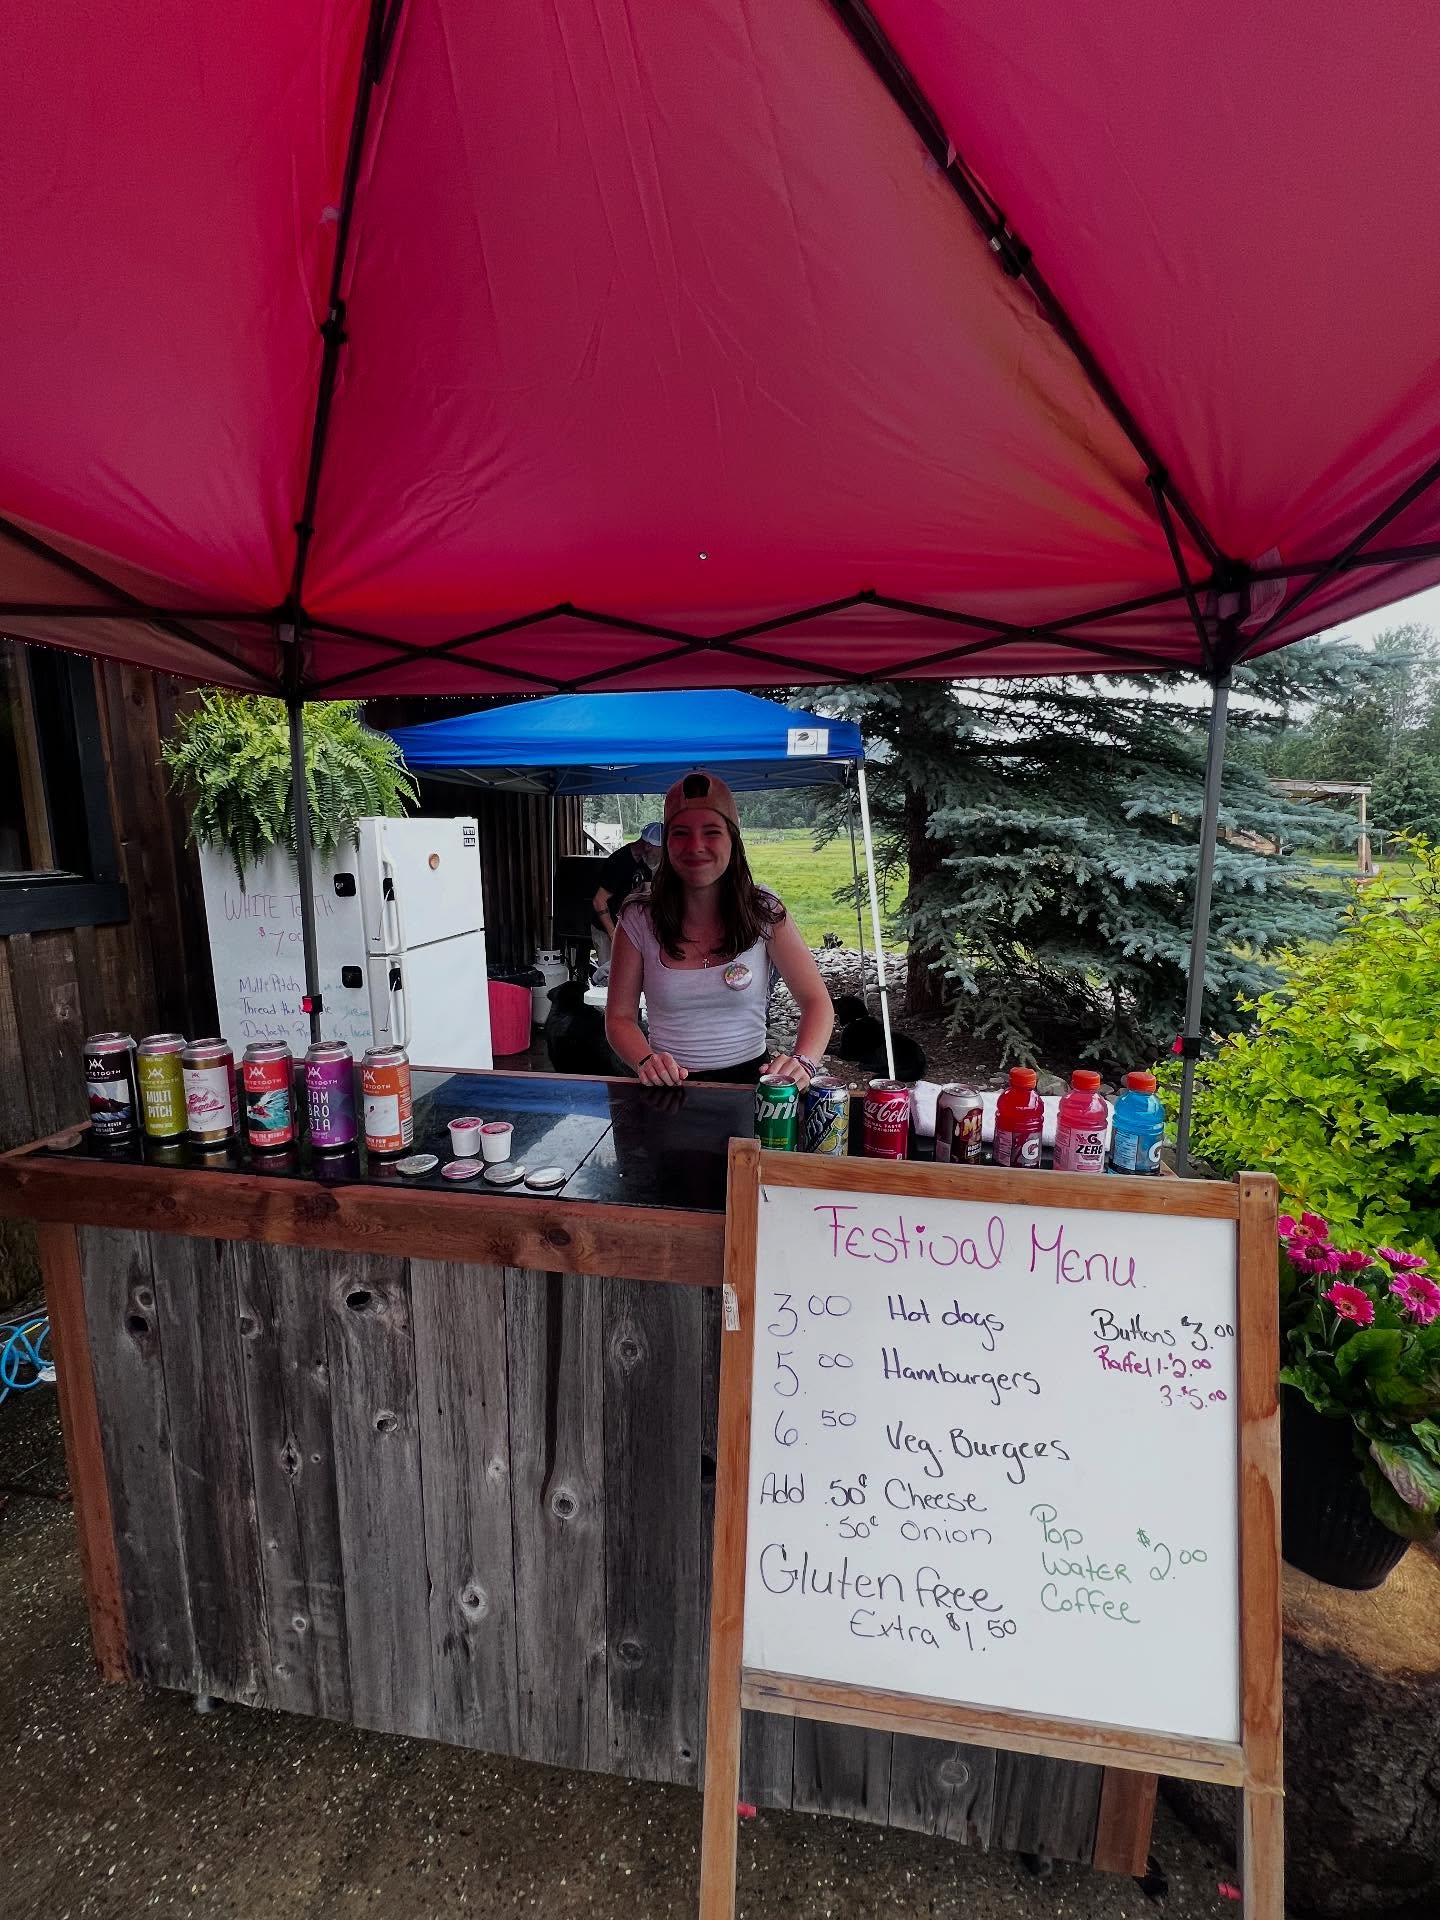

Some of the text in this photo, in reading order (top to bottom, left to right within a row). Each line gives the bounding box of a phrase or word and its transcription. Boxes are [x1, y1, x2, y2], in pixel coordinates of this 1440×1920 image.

[224, 890, 335, 921] WHITE TOTH
[240, 997, 276, 1015] Thread
[146, 1089, 172, 1104] MULTI
[147, 1104, 173, 1118] PITCH
[813, 1205, 1005, 1269] Festival
[767, 1292, 852, 1337] 3.00
[887, 1294, 931, 1325] Hot
[942, 1308, 1005, 1351] dogs
[1090, 1308, 1176, 1347] Buttons
[773, 1346, 1041, 1406] 5.00 Hamburgers
[774, 1410, 857, 1447] 6.50
[760, 1472, 805, 1505] Add
[884, 1478, 988, 1512] Cheese
[899, 1519, 992, 1544] Onion
[1030, 1503, 1084, 1551] Pop
[759, 1543, 905, 1602] Gluten
[1040, 1582, 1142, 1624] Coffee
[849, 1608, 940, 1649] Extra
